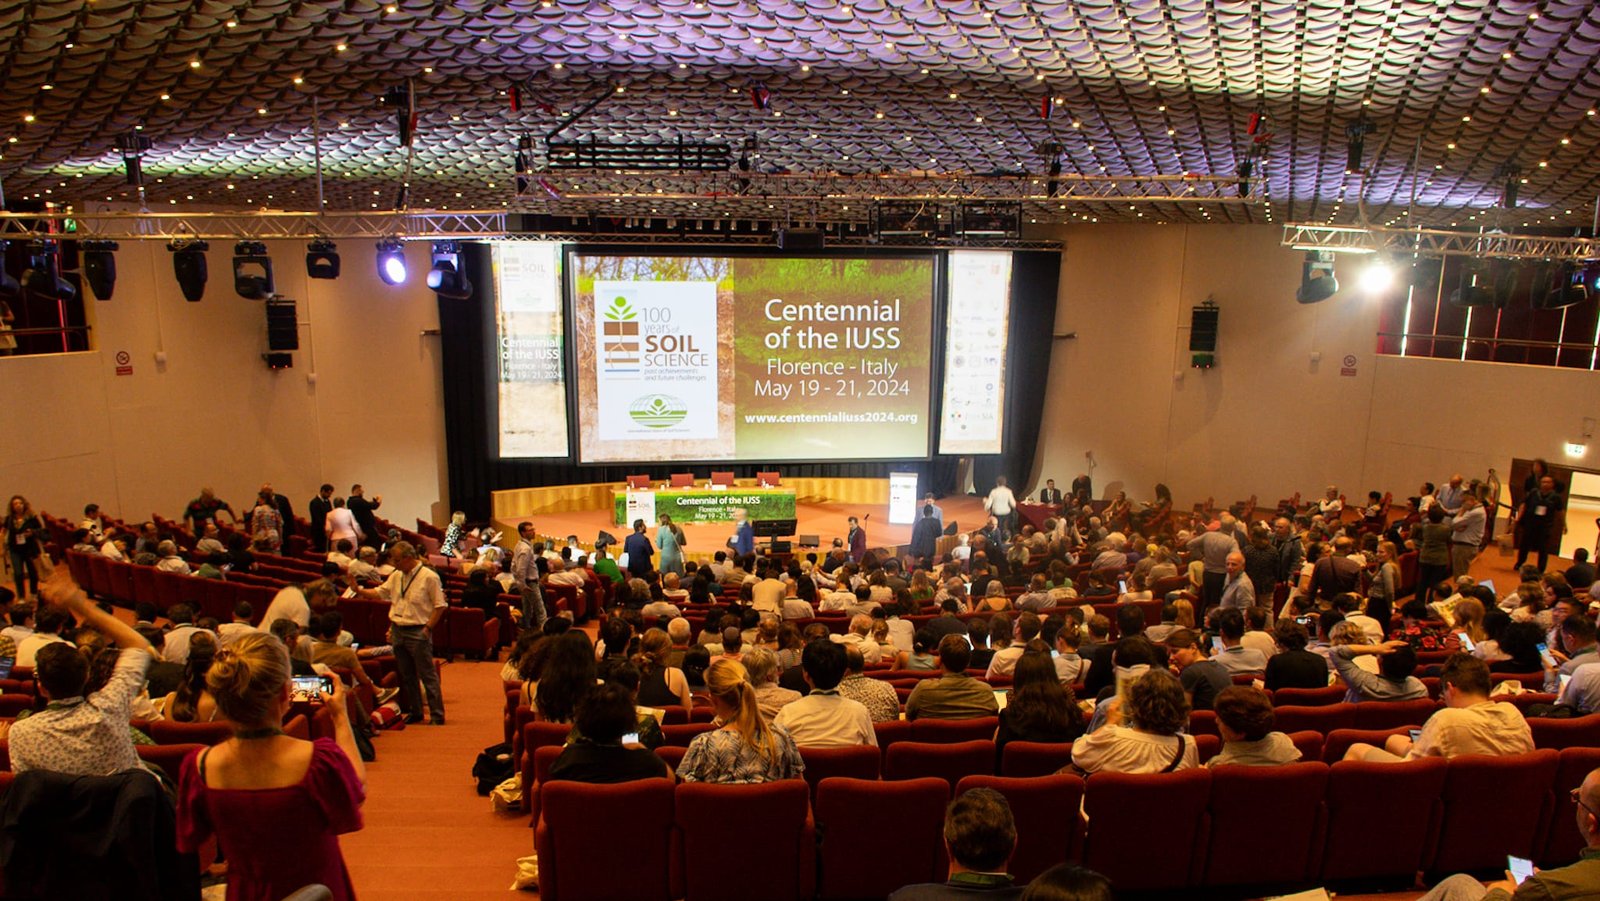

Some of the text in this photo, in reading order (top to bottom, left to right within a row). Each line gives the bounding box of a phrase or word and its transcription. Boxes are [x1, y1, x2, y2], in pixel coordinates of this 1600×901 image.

[641, 307, 671, 323] 100
[765, 299, 900, 321] Centennial
[644, 324, 670, 337] years
[765, 326, 900, 349] of the IUSS
[502, 337, 559, 349] Centennial
[645, 335, 700, 353] SOIL
[502, 348, 559, 360] of the IUSS
[644, 354, 709, 367] SCIENCE
[767, 358, 845, 376] Florence
[861, 358, 899, 379] Italy
[754, 380, 793, 400] May
[799, 379, 820, 396] 19
[836, 379, 862, 398] 21,
[867, 379, 911, 396] 2024
[745, 412, 918, 425] www.centennialiuss2024.org
[676, 496, 760, 505] Centennial of the IUSS
